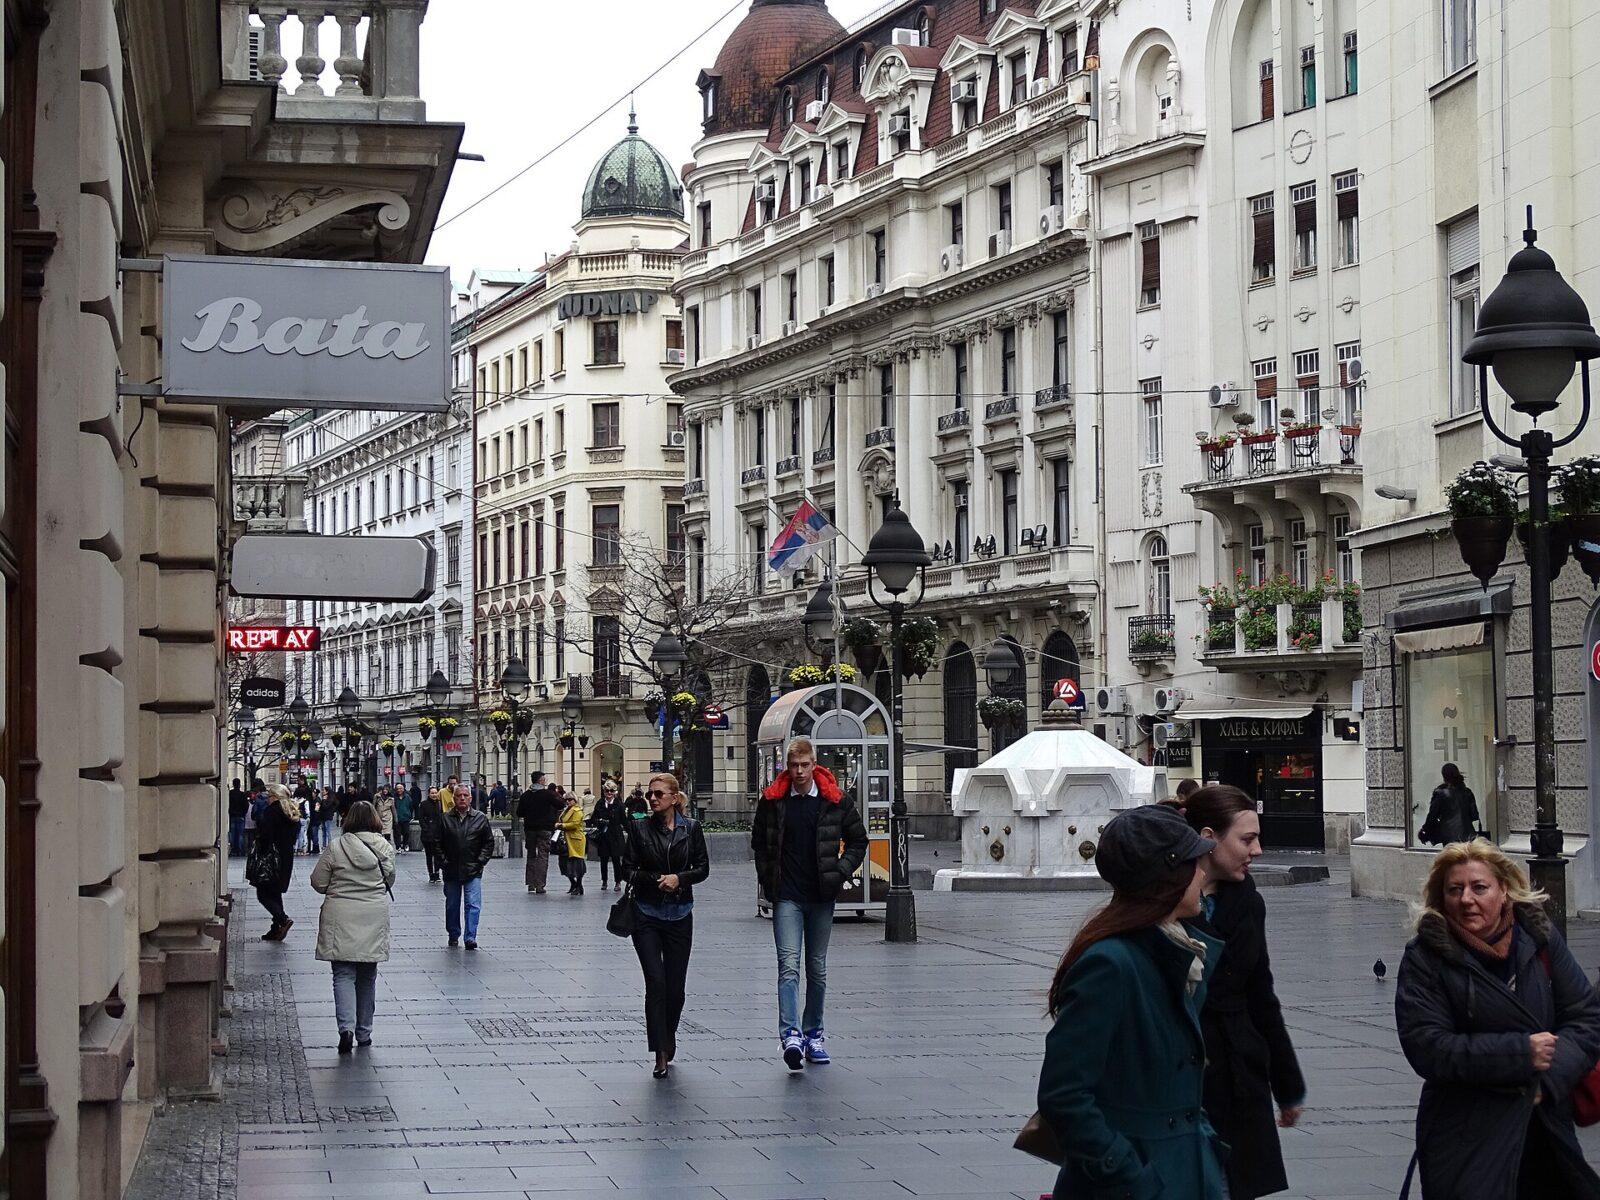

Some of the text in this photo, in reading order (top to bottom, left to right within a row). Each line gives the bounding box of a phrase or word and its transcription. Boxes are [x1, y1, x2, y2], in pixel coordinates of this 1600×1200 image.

[558, 290, 658, 320] RUDNAP
[181, 297, 431, 360] Bata
[229, 630, 313, 648] REPLAY
[246, 688, 279, 697] adidas
[1220, 721, 1304, 736] ХЛЕБ & КИФЛЕ
[1169, 747, 1190, 756] ХЛЕБ
